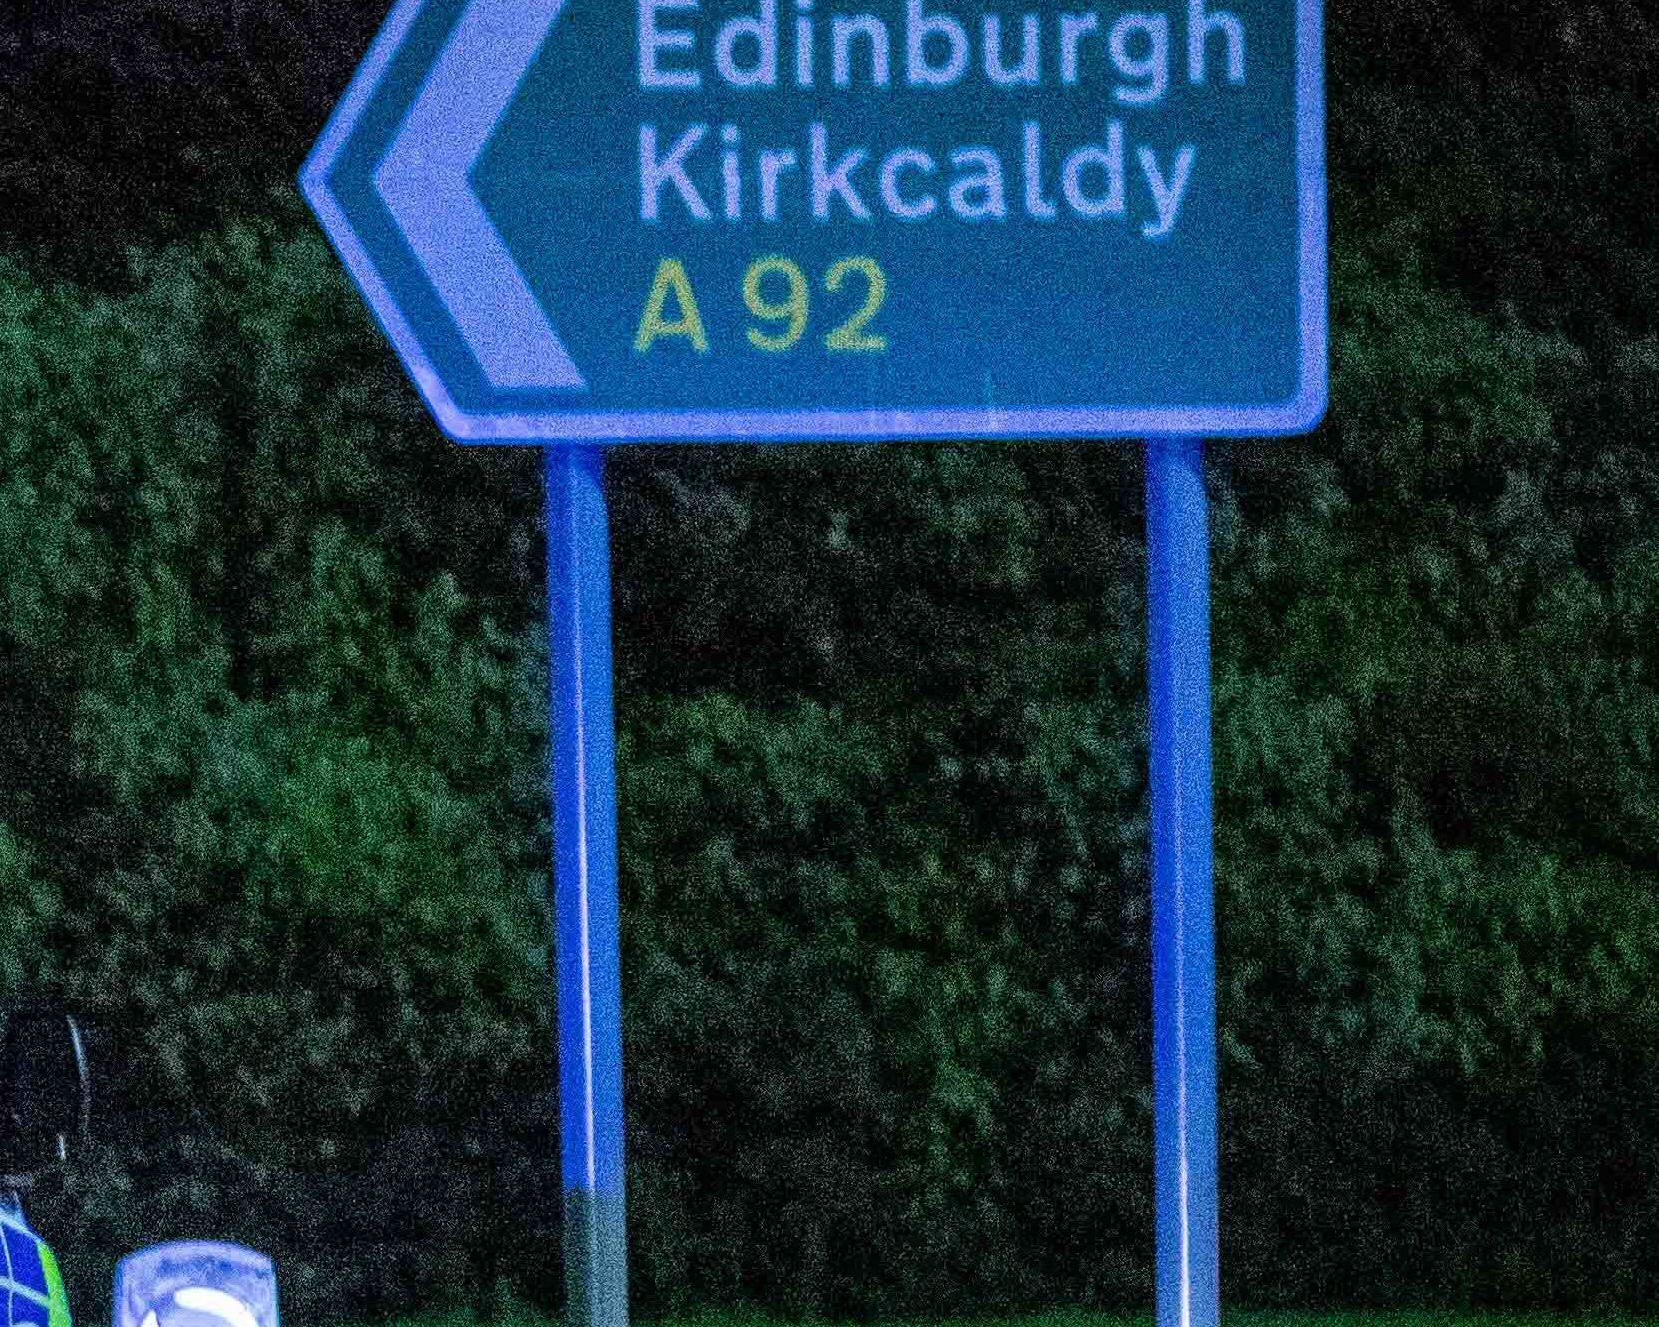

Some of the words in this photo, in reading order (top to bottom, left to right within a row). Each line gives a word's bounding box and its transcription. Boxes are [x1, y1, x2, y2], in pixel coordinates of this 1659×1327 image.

[636, 121, 1195, 237] Kirkcaldy
[635, 256, 710, 355] A
[743, 254, 888, 353] 92
